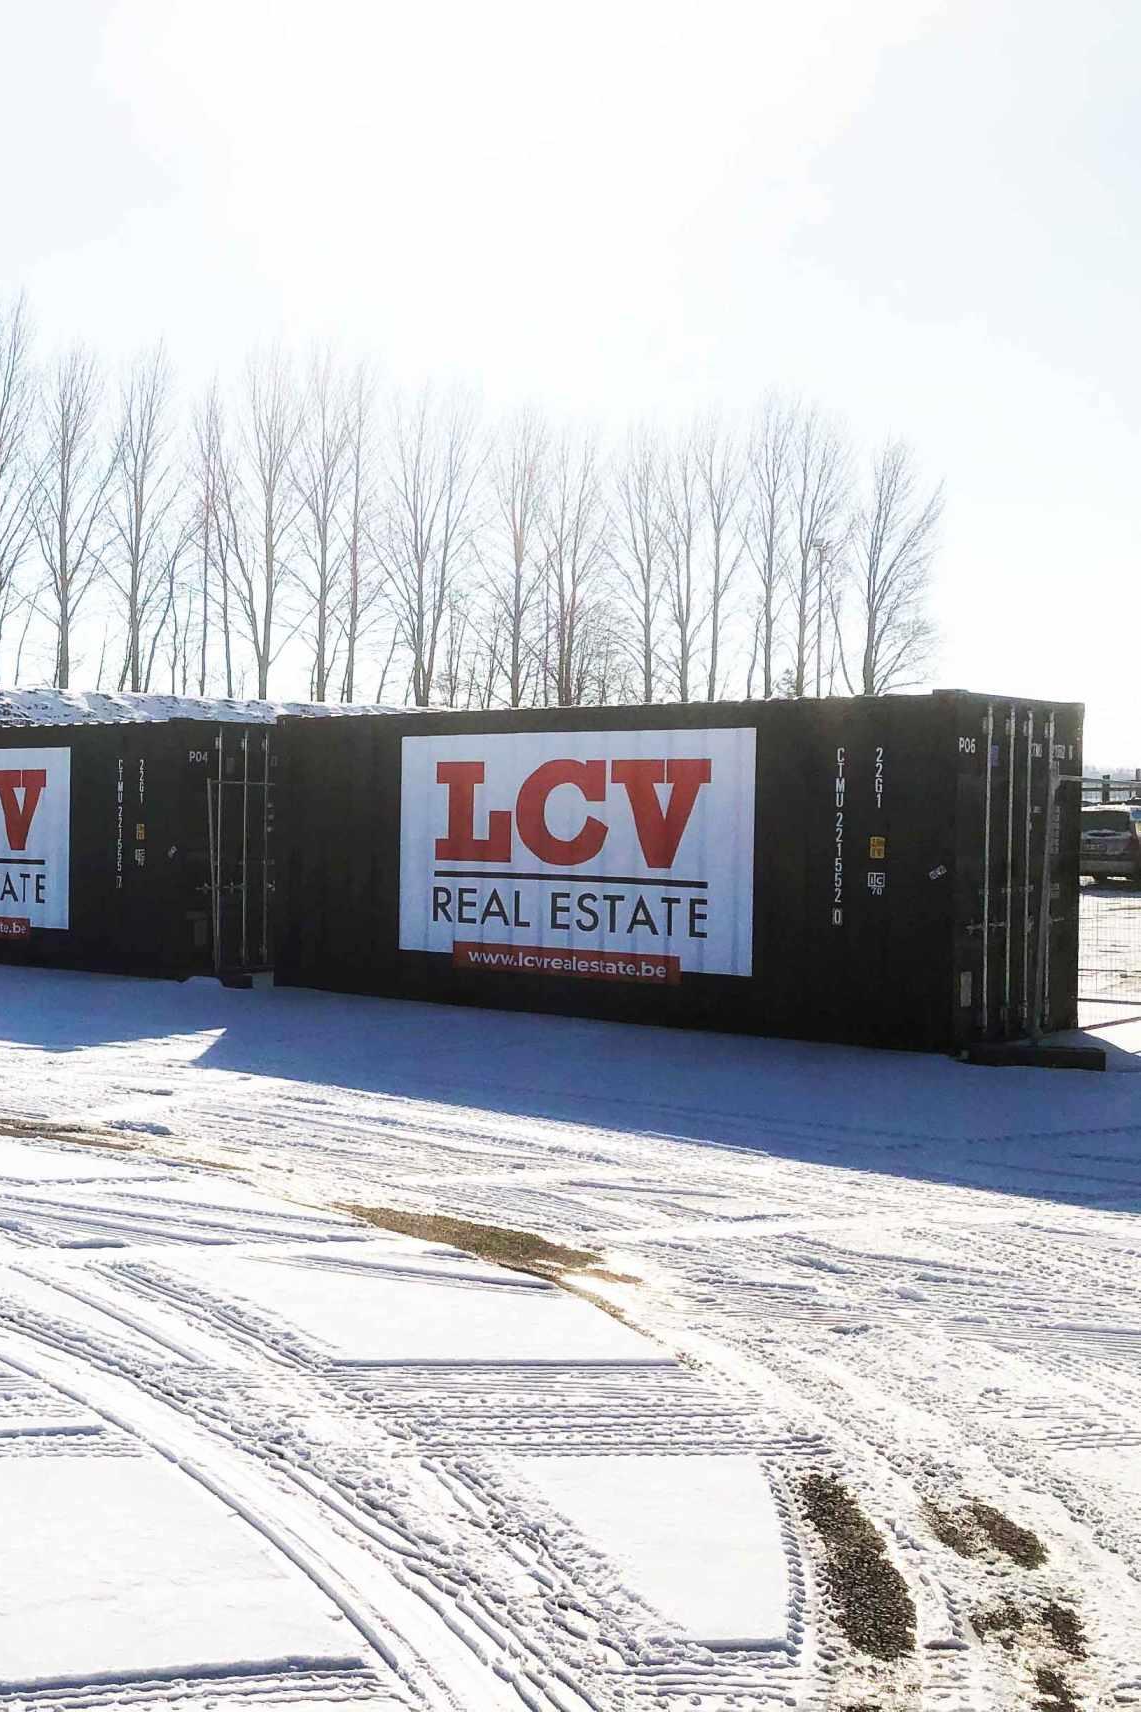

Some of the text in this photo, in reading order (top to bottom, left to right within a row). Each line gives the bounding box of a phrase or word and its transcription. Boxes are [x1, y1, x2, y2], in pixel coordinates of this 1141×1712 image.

[835, 747, 845, 808] CTMU
[875, 747, 883, 808] 22G1
[435, 759, 712, 869] LCV
[432, 886, 708, 939] REAL ESTATE
[468, 951, 667, 978] www.lcvrealestate.be
